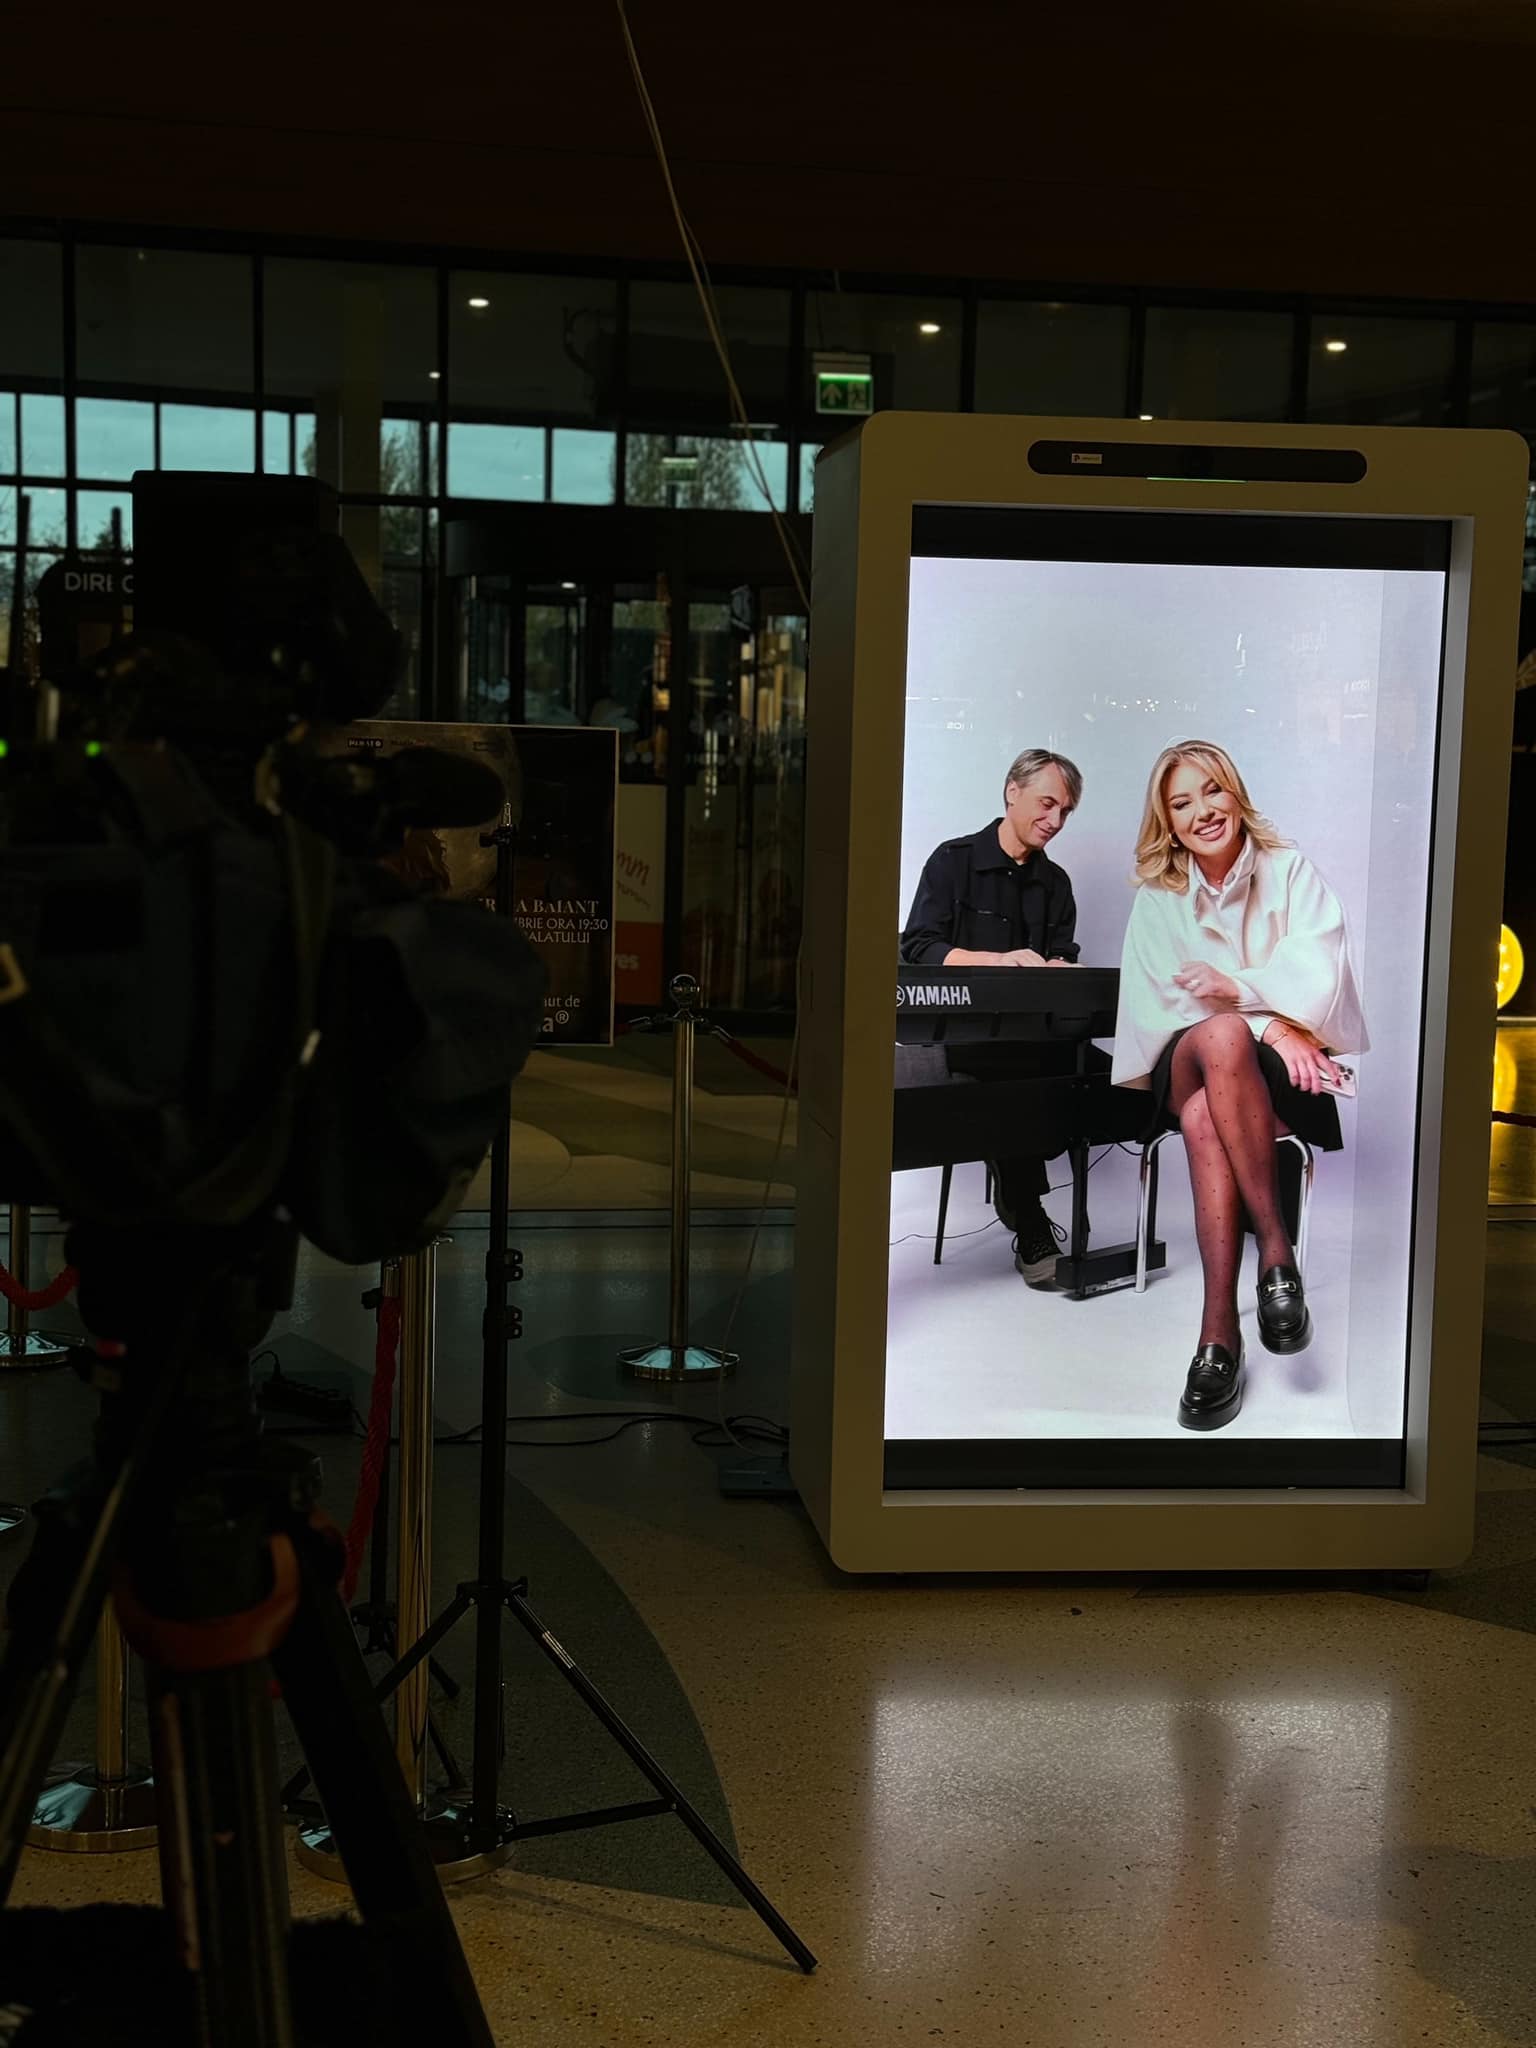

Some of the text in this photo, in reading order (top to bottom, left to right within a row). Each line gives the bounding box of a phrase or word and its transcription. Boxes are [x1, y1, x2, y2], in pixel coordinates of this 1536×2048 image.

[546, 918, 575, 929] ORA
[579, 918, 608, 930] 19:30
[524, 931, 590, 943] ALATULUI
[564, 994, 581, 1008] de
[905, 985, 972, 1006] YAMAHA
